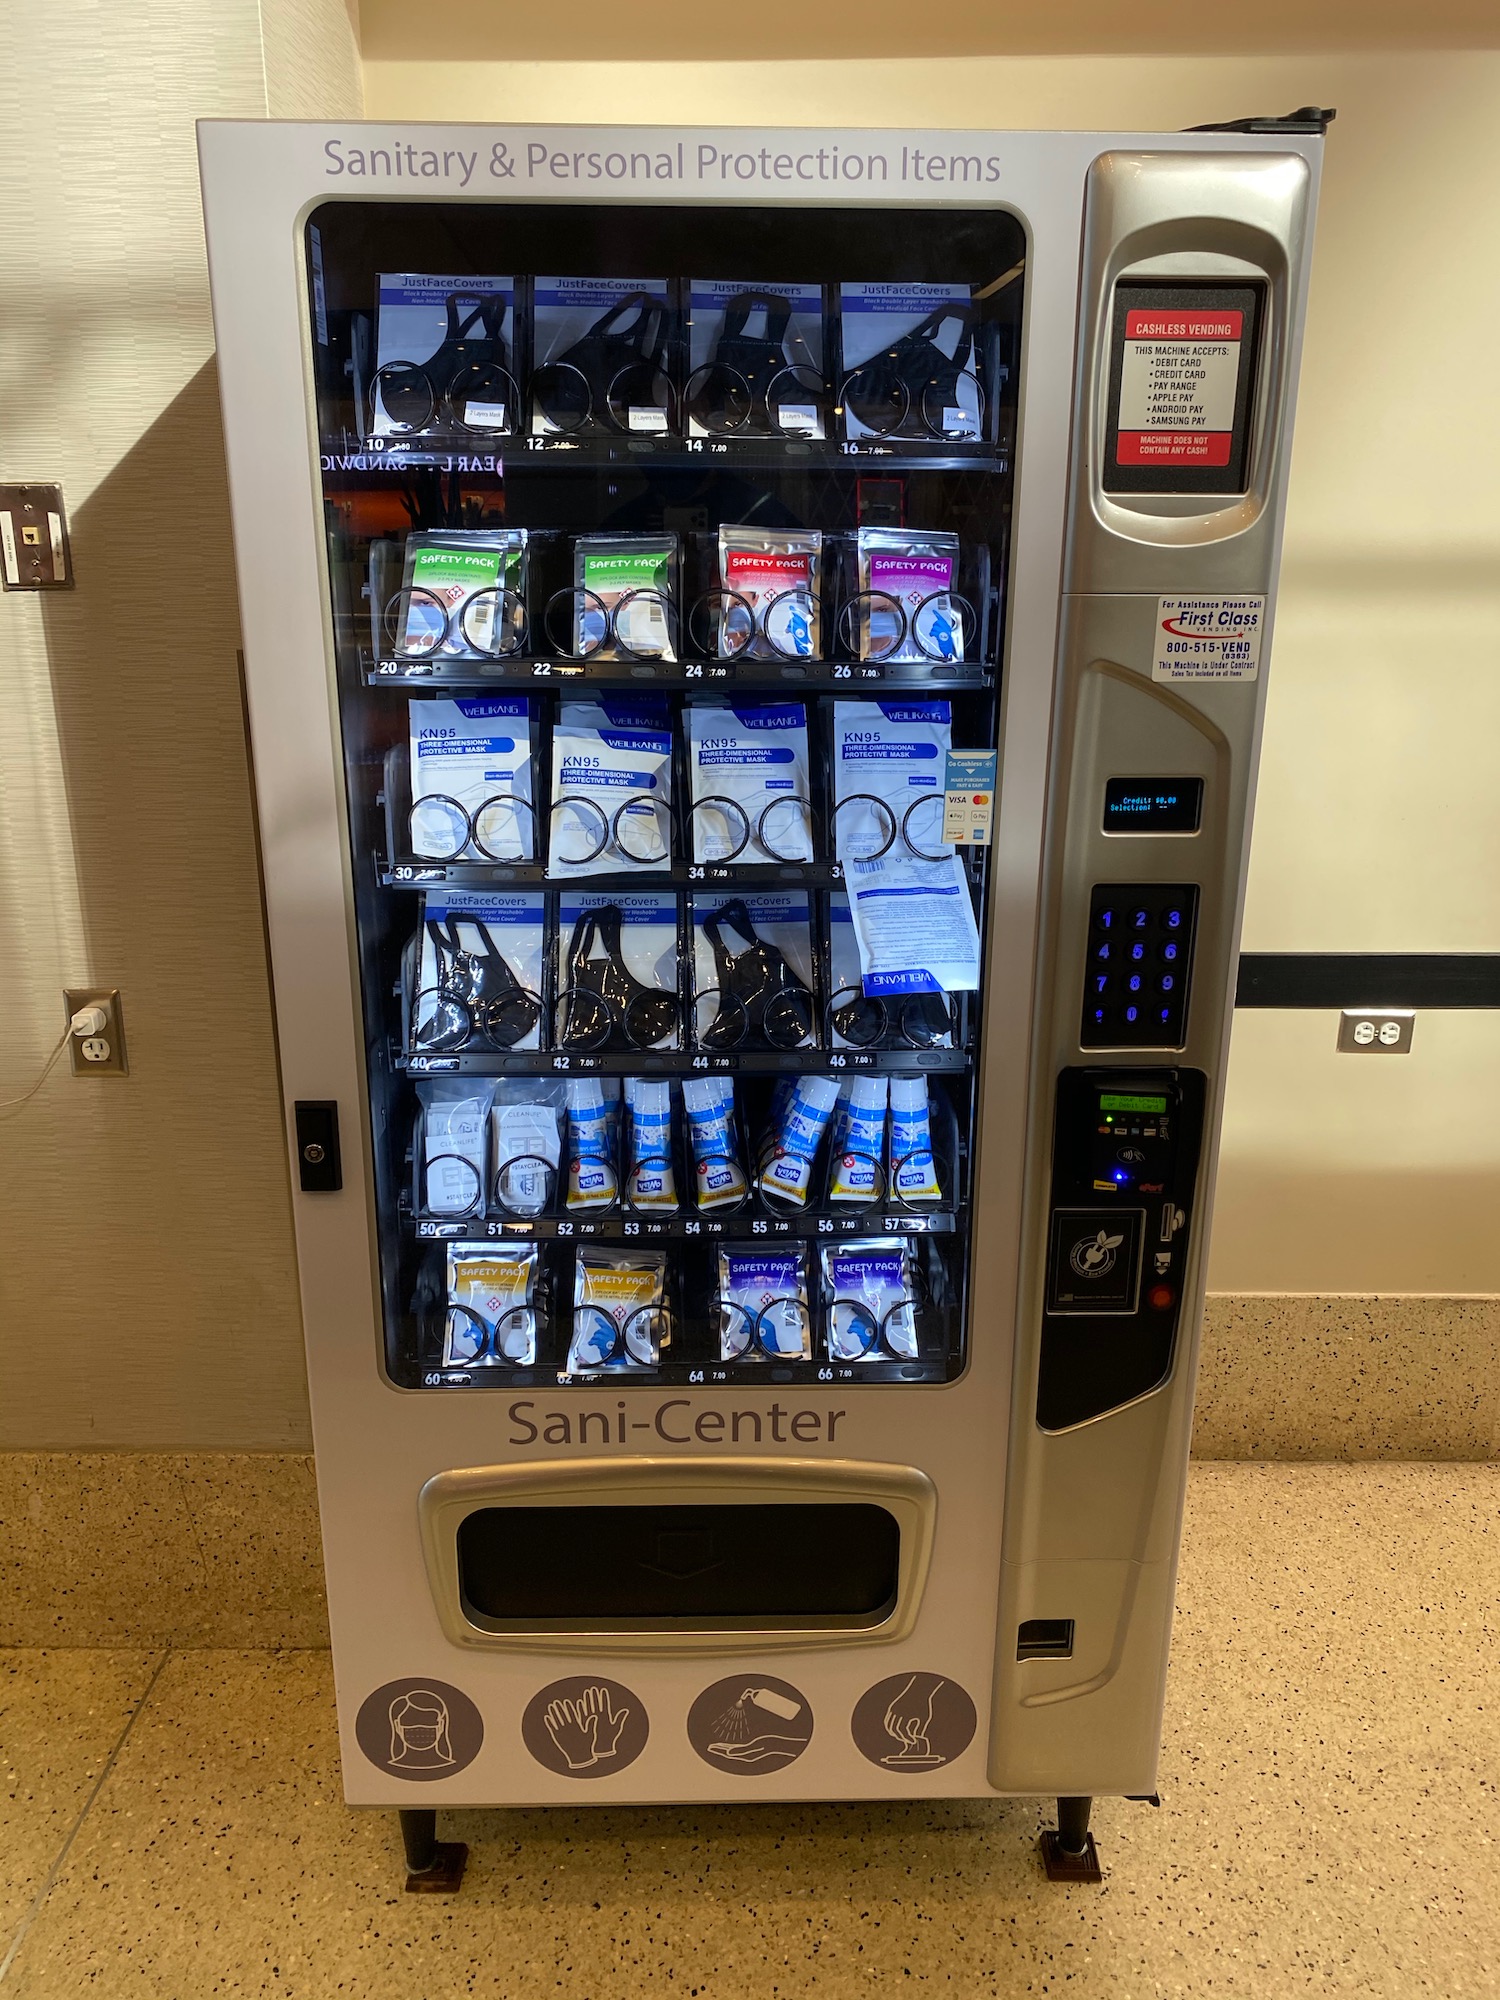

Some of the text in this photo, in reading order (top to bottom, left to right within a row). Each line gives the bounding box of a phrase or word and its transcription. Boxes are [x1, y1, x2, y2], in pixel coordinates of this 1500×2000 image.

[324, 139, 1001, 187] Sanitary & Personal Protection Items
[401, 277, 493, 288] JustFaceCovers
[556, 279, 647, 290] JustFaceCovers
[862, 285, 951, 295] JustFaceCovers
[1136, 323, 1231, 335] CASHLESS VENDING
[1135, 346, 1230, 356] THIS MACHINE ACCEPTS:
[1156, 359, 1202, 367] DEBIT CARD
[1155, 370, 1206, 379] CREDIT CARD
[1154, 382, 1197, 391] PAY RANGE
[1153, 394, 1194, 402] APPLE PAY
[1152, 405, 1204, 414] ANDROID PAY
[1151, 417, 1207, 425] SAMSUNG PAY
[366, 438, 385, 451] 10
[526, 438, 544, 451] 12
[685, 439, 727, 453] 14 7.00
[1140, 436, 1208, 445] MACHINE DOES NOT
[841, 442, 859, 455] 16
[1187, 447, 1208, 455] CASH!
[420, 555, 463, 565] SAFETY
[465, 557, 495, 568] PACK
[732, 557, 805, 569] SAFETY PACK
[875, 560, 948, 574] SAFETY PACK
[1162, 601, 1262, 609] For Assistance Please Call
[1179, 611, 1258, 626] First Class
[1167, 642, 1251, 653] 800-515-VEND
[379, 661, 398, 675] 20
[533, 663, 552, 677] 22
[1159, 661, 1172, 669] This
[1174, 661, 1200, 669] Machine
[1210, 661, 1229, 669] Under
[1231, 661, 1255, 669] Contract
[685, 665, 727, 678] 24 7.00
[834, 665, 877, 679] 26 7.00
[465, 705, 519, 716] WEILIKANG
[744, 716, 797, 728] WEILIKANG
[420, 728, 456, 740] KN95
[420, 739, 493, 749] THREE-DIMENSIONAL
[608, 739, 662, 750] WEILIKANG
[701, 738, 737, 750] KN95
[420, 748, 463, 756] PROTECTIVE
[701, 750, 773, 758] THREE-DIMENSIONAL
[563, 756, 600, 768] KN95
[563, 770, 636, 780] THREE-DIMENSIONAL
[563, 776, 607, 785] PROTECTIVE
[1123, 797, 1152, 805] Credit:
[1111, 804, 1151, 812] Selection:
[395, 867, 413, 880] 30
[688, 867, 728, 879] 34 7.00
[445, 896, 527, 906] JustFaceCovers
[482, 909, 496, 917] Layer
[1103, 911, 1181, 927] 1 2 3
[1099, 944, 1177, 960] 4 5 6
[873, 972, 931, 986] WEILIKANG
[1097, 975, 1174, 992] 7 8 9
[1127, 1006, 1137, 1022] 0
[410, 1057, 427, 1069] 40
[554, 1057, 594, 1069] 42 7.00
[693, 1057, 730, 1069] 44 7.00
[830, 1055, 847, 1067] 46
[419, 1225, 436, 1236] 50
[488, 1224, 503, 1235] 51
[558, 1224, 595, 1235] 52 7.00
[624, 1224, 661, 1235] 53 7.00
[685, 1222, 722, 1234] 54 7.00
[752, 1222, 789, 1234] 55 7.00
[818, 1220, 855, 1232] 56 7.00
[885, 1219, 900, 1230] 57
[461, 1268, 526, 1277] SAFETY PACK
[732, 1263, 795, 1273] SAFETY PACK
[837, 1262, 899, 1274] SAFETY PACK
[425, 1373, 441, 1386] 60
[689, 1370, 726, 1383] 64 7.00
[818, 1368, 833, 1381] 66
[508, 1399, 846, 1445] Sani-Center
